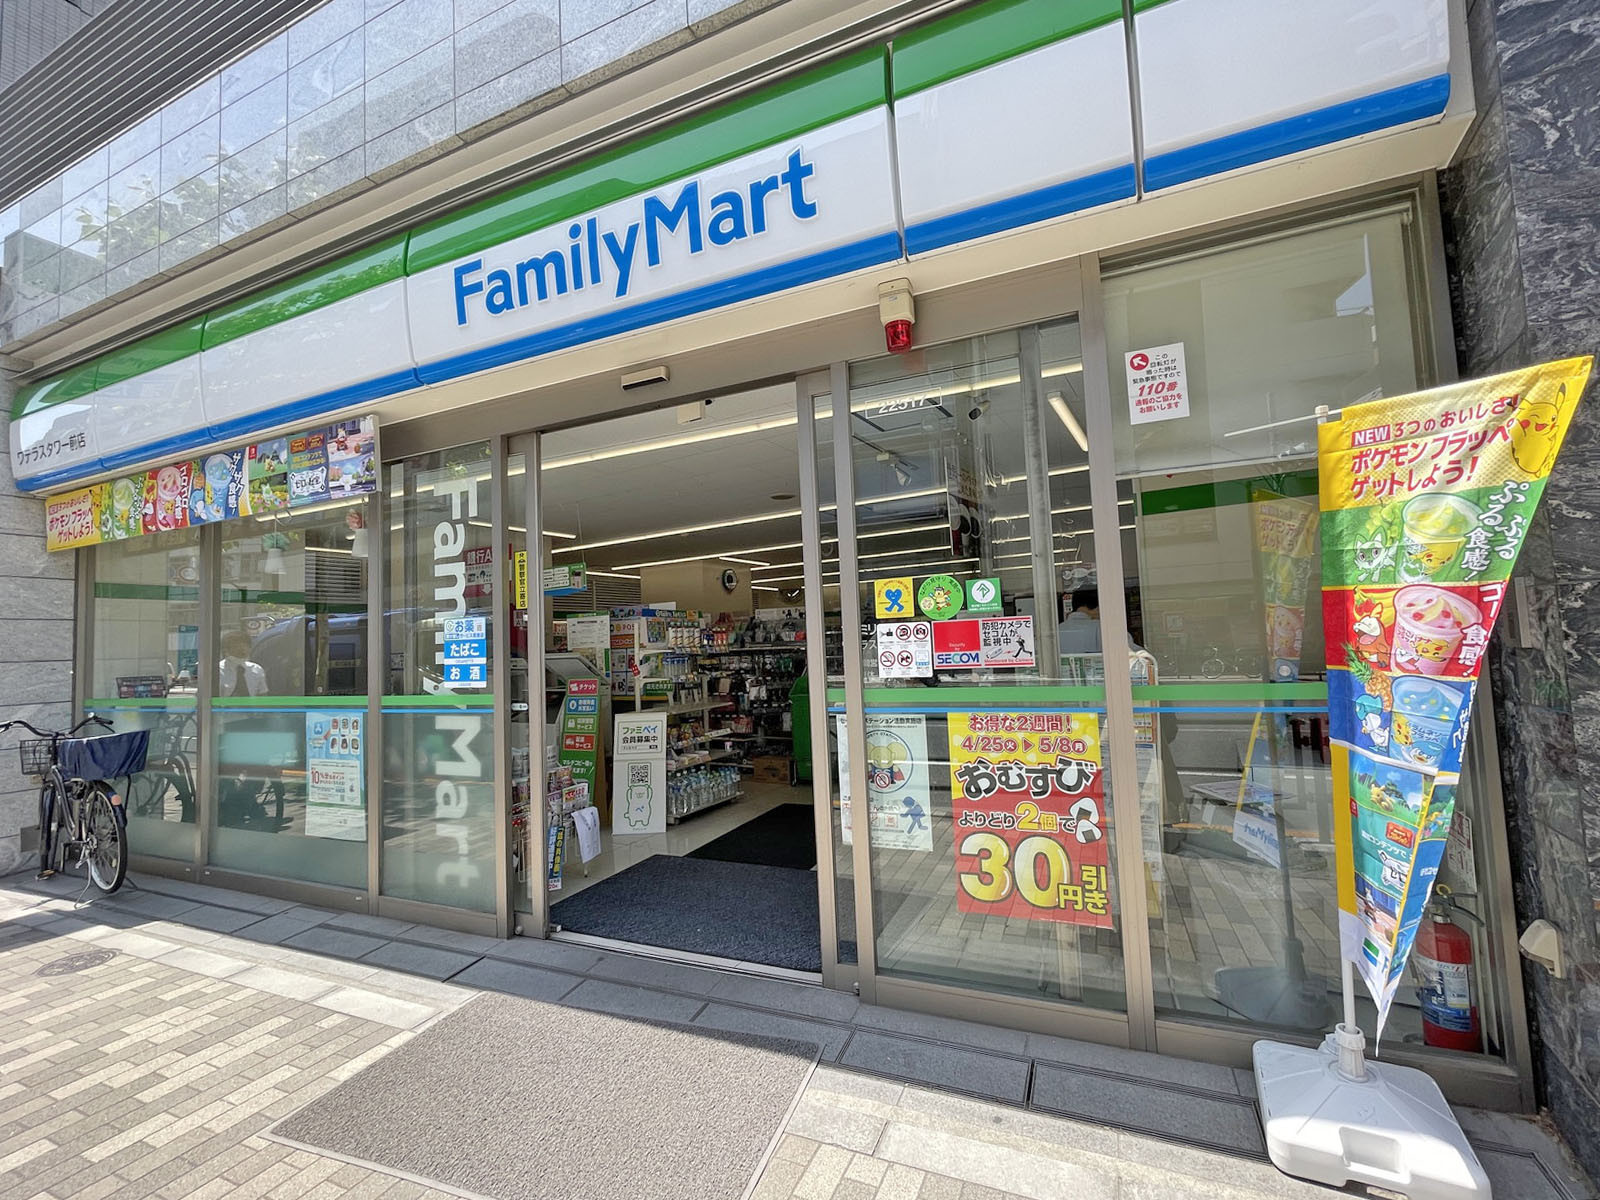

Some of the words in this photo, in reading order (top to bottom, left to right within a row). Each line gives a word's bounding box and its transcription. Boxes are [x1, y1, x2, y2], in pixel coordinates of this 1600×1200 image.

[453, 147, 818, 326] FamilyMart
[1155, 353, 1168, 361] この
[1138, 381, 1178, 397] 110番
[1135, 393, 1183, 406] 通報のご協力を
[1139, 402, 1180, 414] お願いします
[1353, 426, 1390, 445] NEW
[17, 432, 86, 465] ワテラスタワー前店
[1351, 418, 1517, 474] ポケモンフラッペ
[1351, 456, 1479, 501] ゲットしよう!
[1460, 527, 1494, 582] 食感!
[455, 619, 475, 633] お薬
[982, 620, 1031, 631] 防犯カメラで
[983, 629, 1018, 639] セコムが
[983, 637, 1012, 647] 監視中
[450, 643, 480, 657] たばこ
[937, 652, 980, 665] SECOM
[450, 666, 480, 681] お酒
[622, 725, 658, 735] ファミペイ
[969, 714, 1072, 733] お得な2週間!
[622, 735, 658, 744] 会員募集中
[956, 756, 1096, 800] おむすび
[958, 801, 1077, 832] よりどり2個で
[959, 832, 1110, 916] 30円引き
